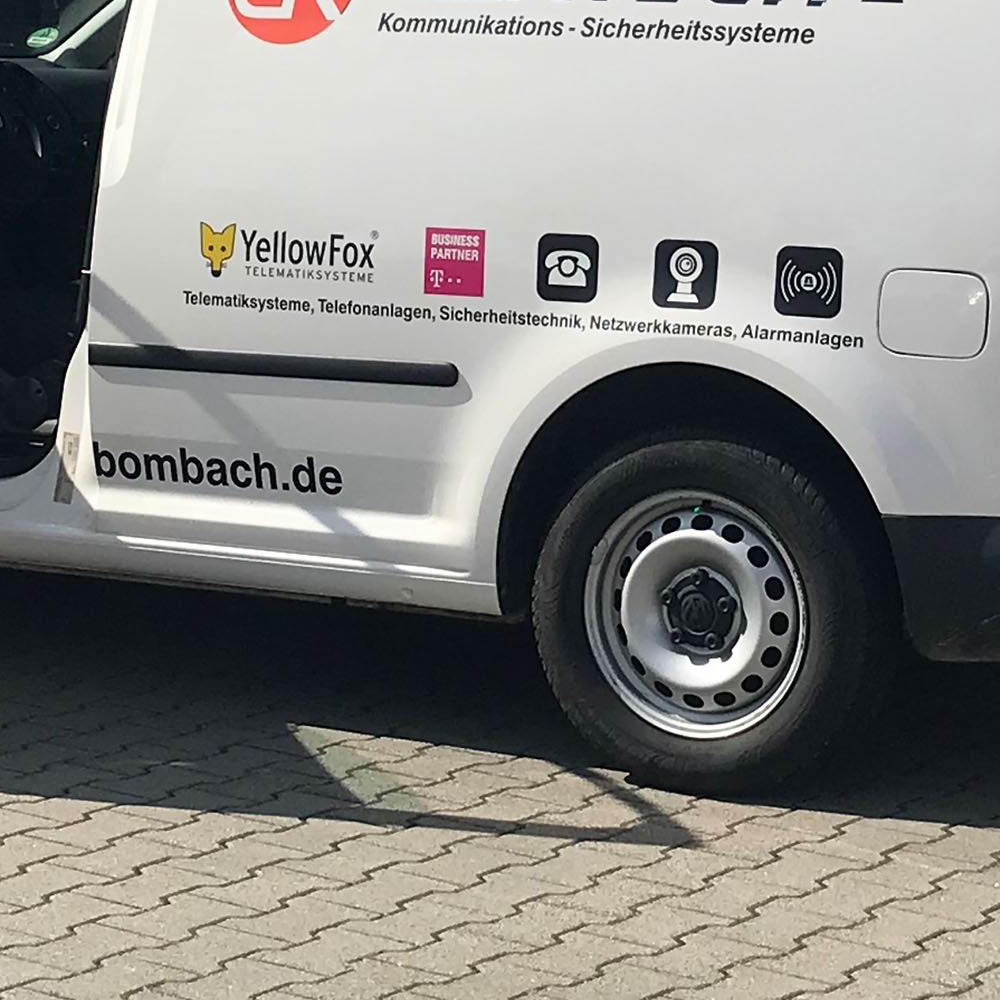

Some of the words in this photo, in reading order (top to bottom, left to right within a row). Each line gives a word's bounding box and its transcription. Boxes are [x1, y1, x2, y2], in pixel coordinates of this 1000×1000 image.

[378, 12, 564, 37] Kommunikations
[580, 17, 815, 47] Sicherheitssysteme
[240, 229, 375, 270] YellowFox
[430, 248, 479, 262] PARTNER
[431, 233, 480, 247] BUSINESS
[244, 266, 375, 284] TELEMATIKSYSTEME
[182, 290, 315, 315] Telematiksysteme,
[317, 299, 436, 323] Telefonanlagen,
[440, 305, 585, 331] Sicherheitstechnik,
[589, 315, 738, 340] Netzwerkkameras,
[741, 327, 864, 350] Alarmanlagen
[92, 440, 343, 496] bombach.de
